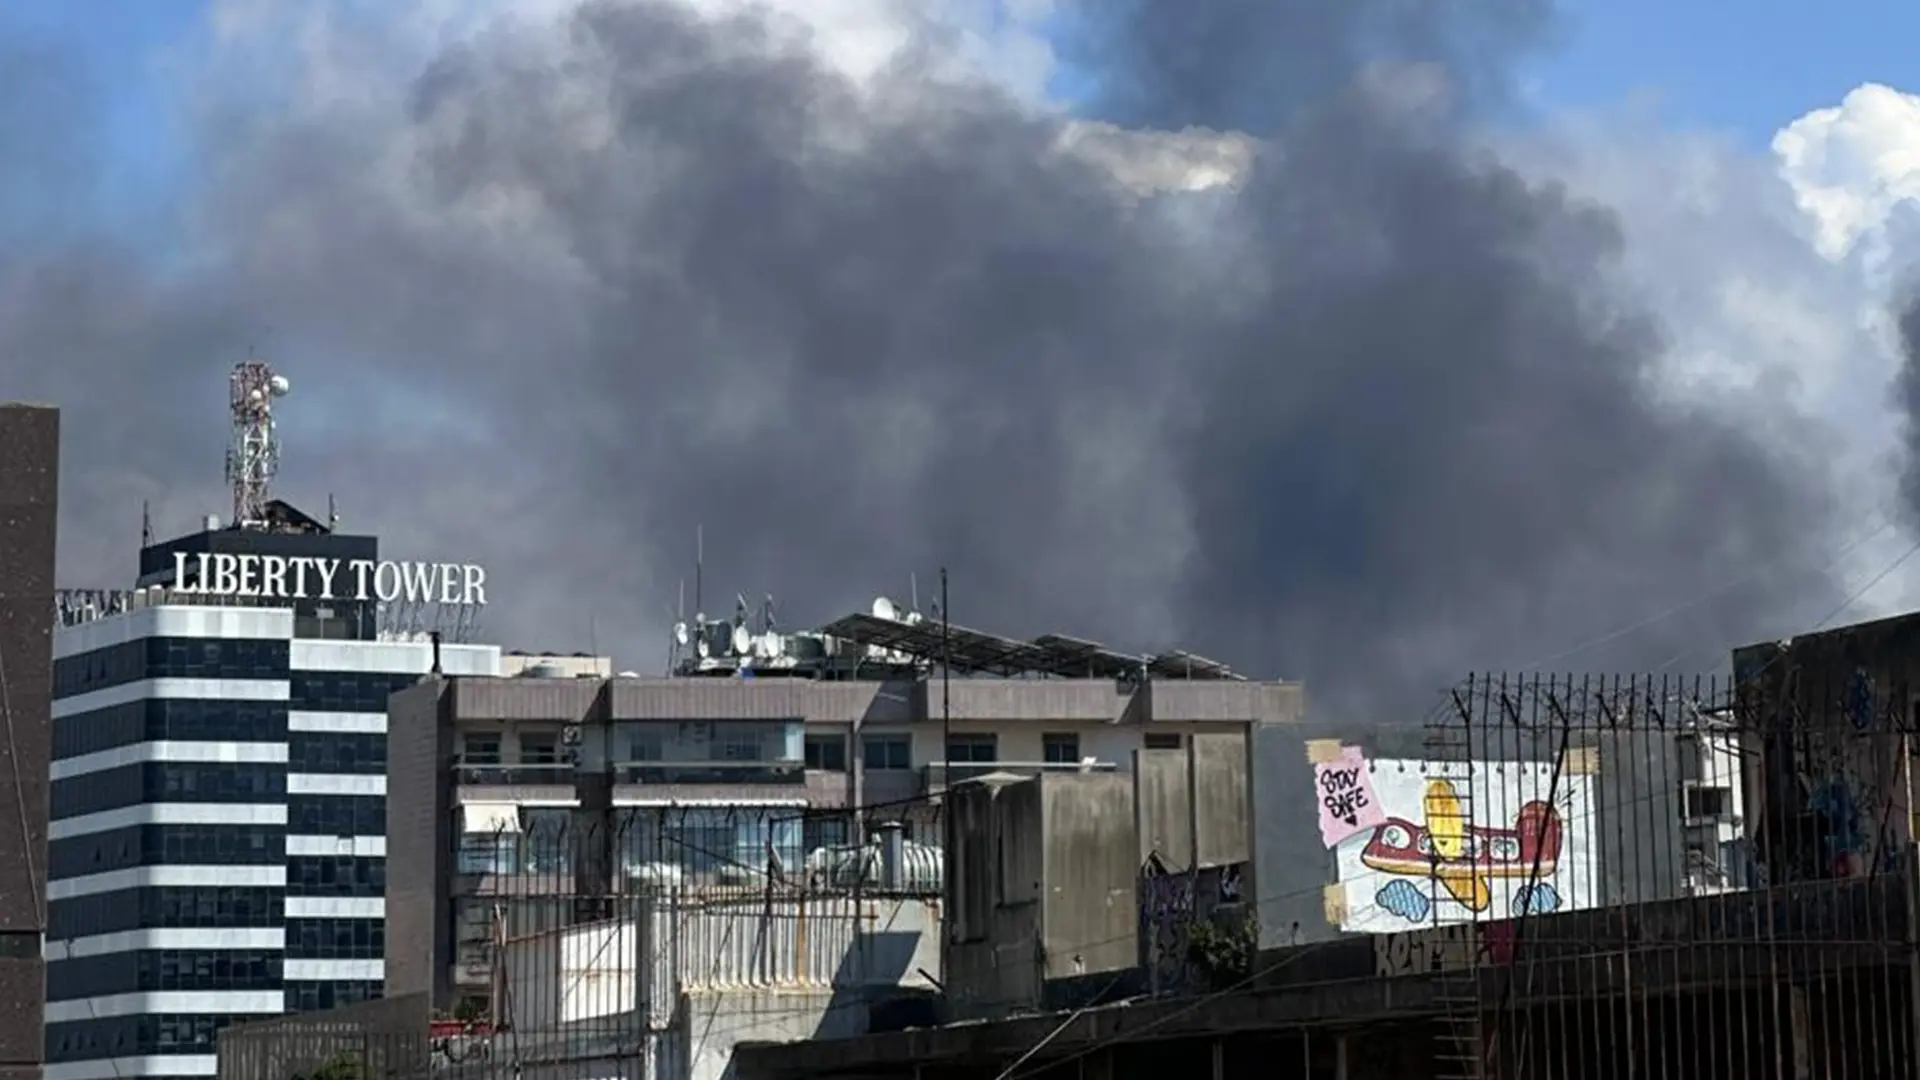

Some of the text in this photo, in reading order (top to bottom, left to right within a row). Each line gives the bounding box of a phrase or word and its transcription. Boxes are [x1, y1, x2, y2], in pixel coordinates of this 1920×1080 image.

[173, 552, 488, 604] LIBERTY TOWER
[1320, 767, 1359, 794] STAY
[1324, 786, 1369, 818] SAFE
